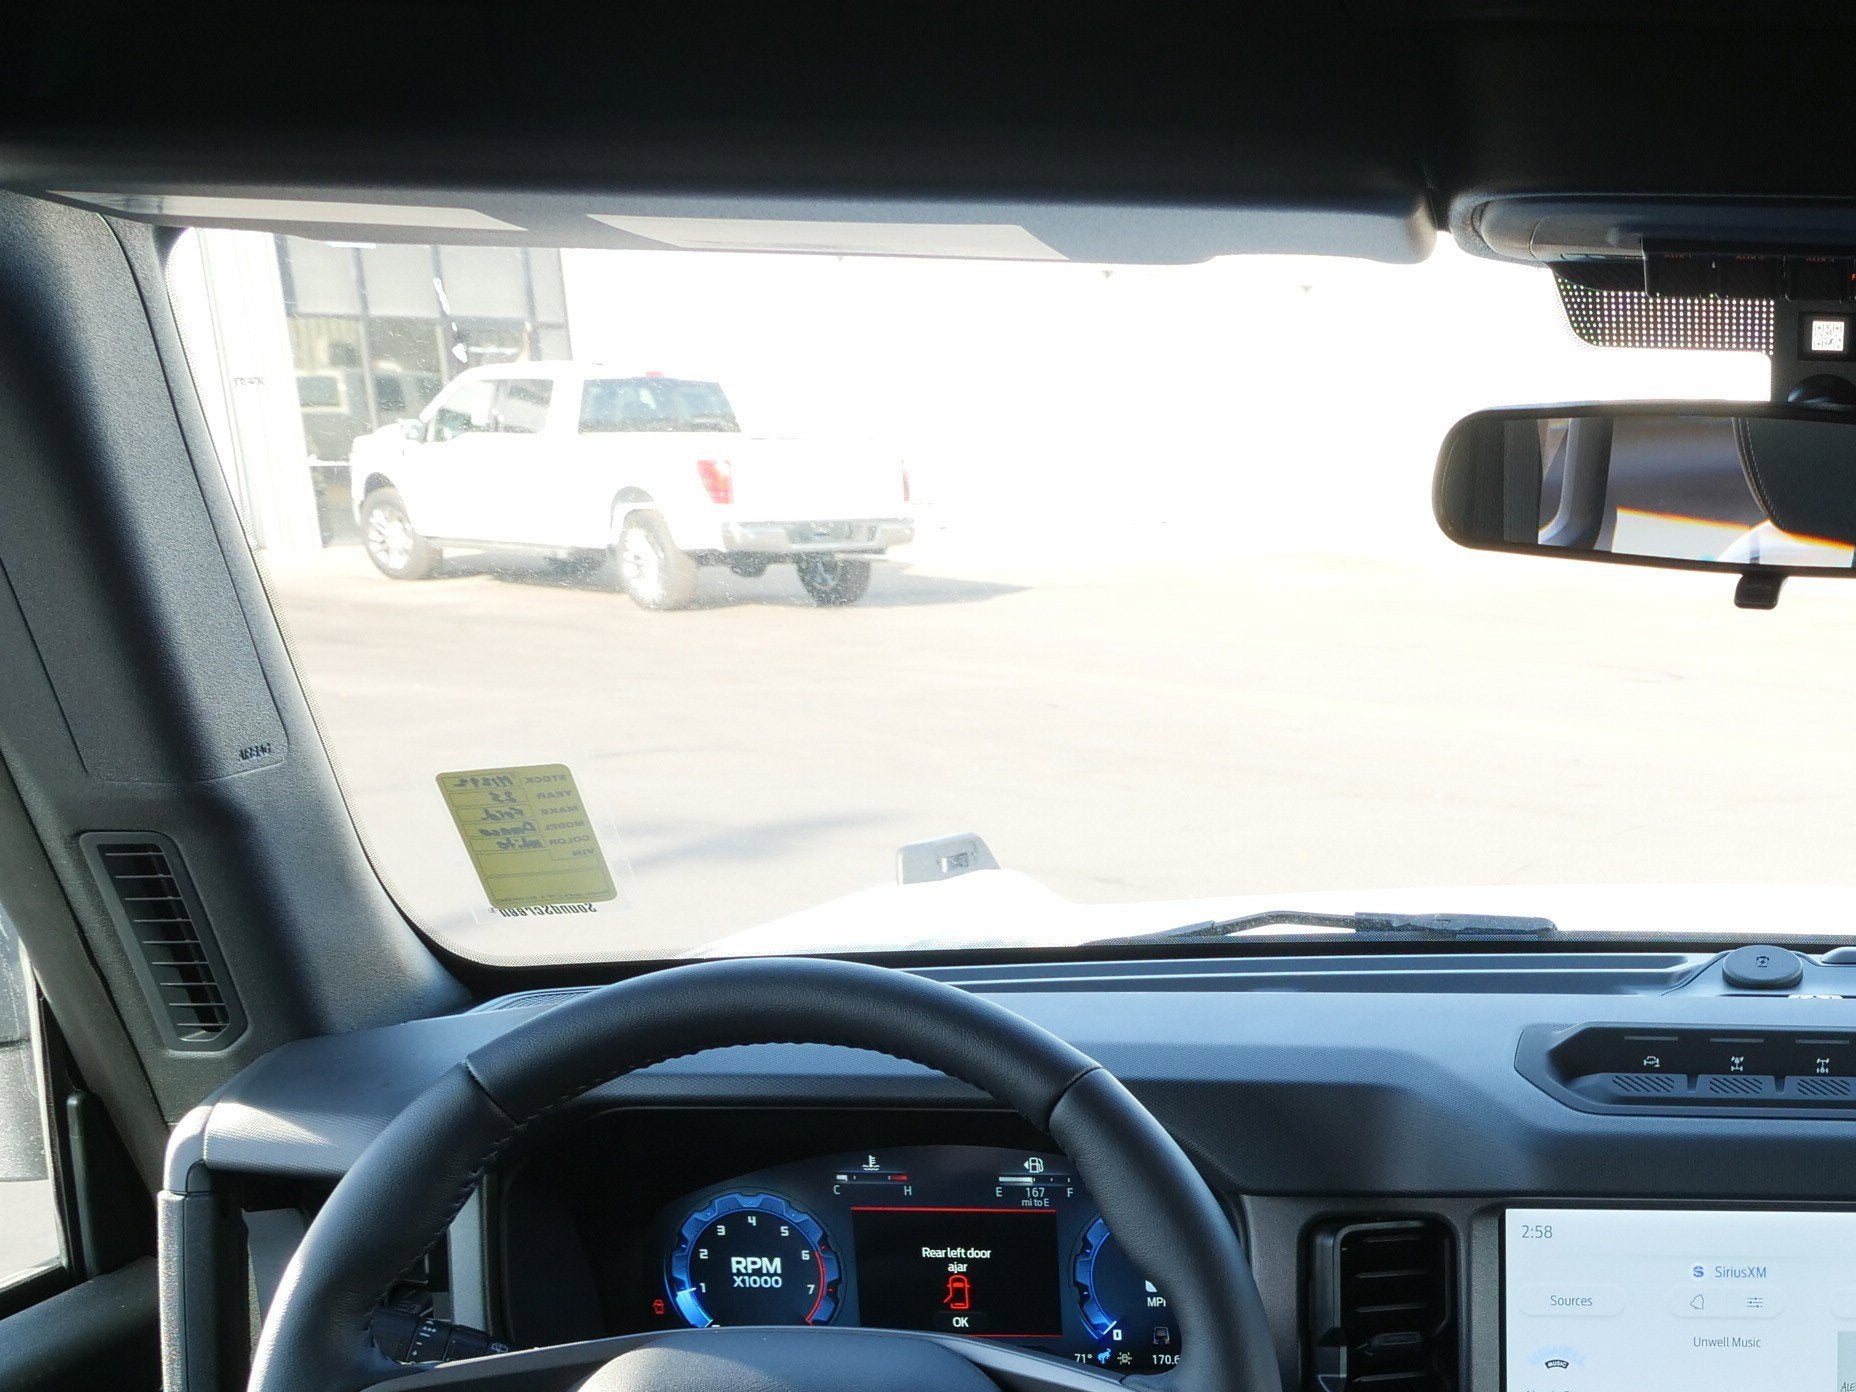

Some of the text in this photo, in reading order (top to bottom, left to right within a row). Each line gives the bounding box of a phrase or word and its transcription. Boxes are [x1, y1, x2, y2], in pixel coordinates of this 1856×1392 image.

[833, 1185, 841, 1195] C
[904, 1186, 912, 1196] H
[996, 1187, 1003, 1197] E
[1025, 1187, 1045, 1198] 167
[1067, 1188, 1074, 1198] F
[1021, 1199, 1050, 1207] mi to E
[748, 1216, 756, 1226] 4
[717, 1225, 726, 1235] 3
[780, 1226, 789, 1236] 5
[1521, 1225, 1553, 1239] 2:58
[699, 1249, 708, 1259] 2
[801, 1250, 810, 1260] 6
[922, 1247, 991, 1259] Rear left door
[731, 1257, 782, 1274] RPM
[948, 1263, 968, 1274] ajar
[1715, 1266, 1767, 1278] SiriusXM
[732, 1276, 782, 1288] X1000
[700, 1283, 706, 1293] 1
[807, 1285, 815, 1294] 7
[1550, 1295, 1593, 1307] Sources
[952, 1317, 969, 1328] OK
[1112, 1330, 1122, 1340] 0
[1693, 1337, 1761, 1348] Unwell Music
[1074, 1353, 1093, 1364] 71°
